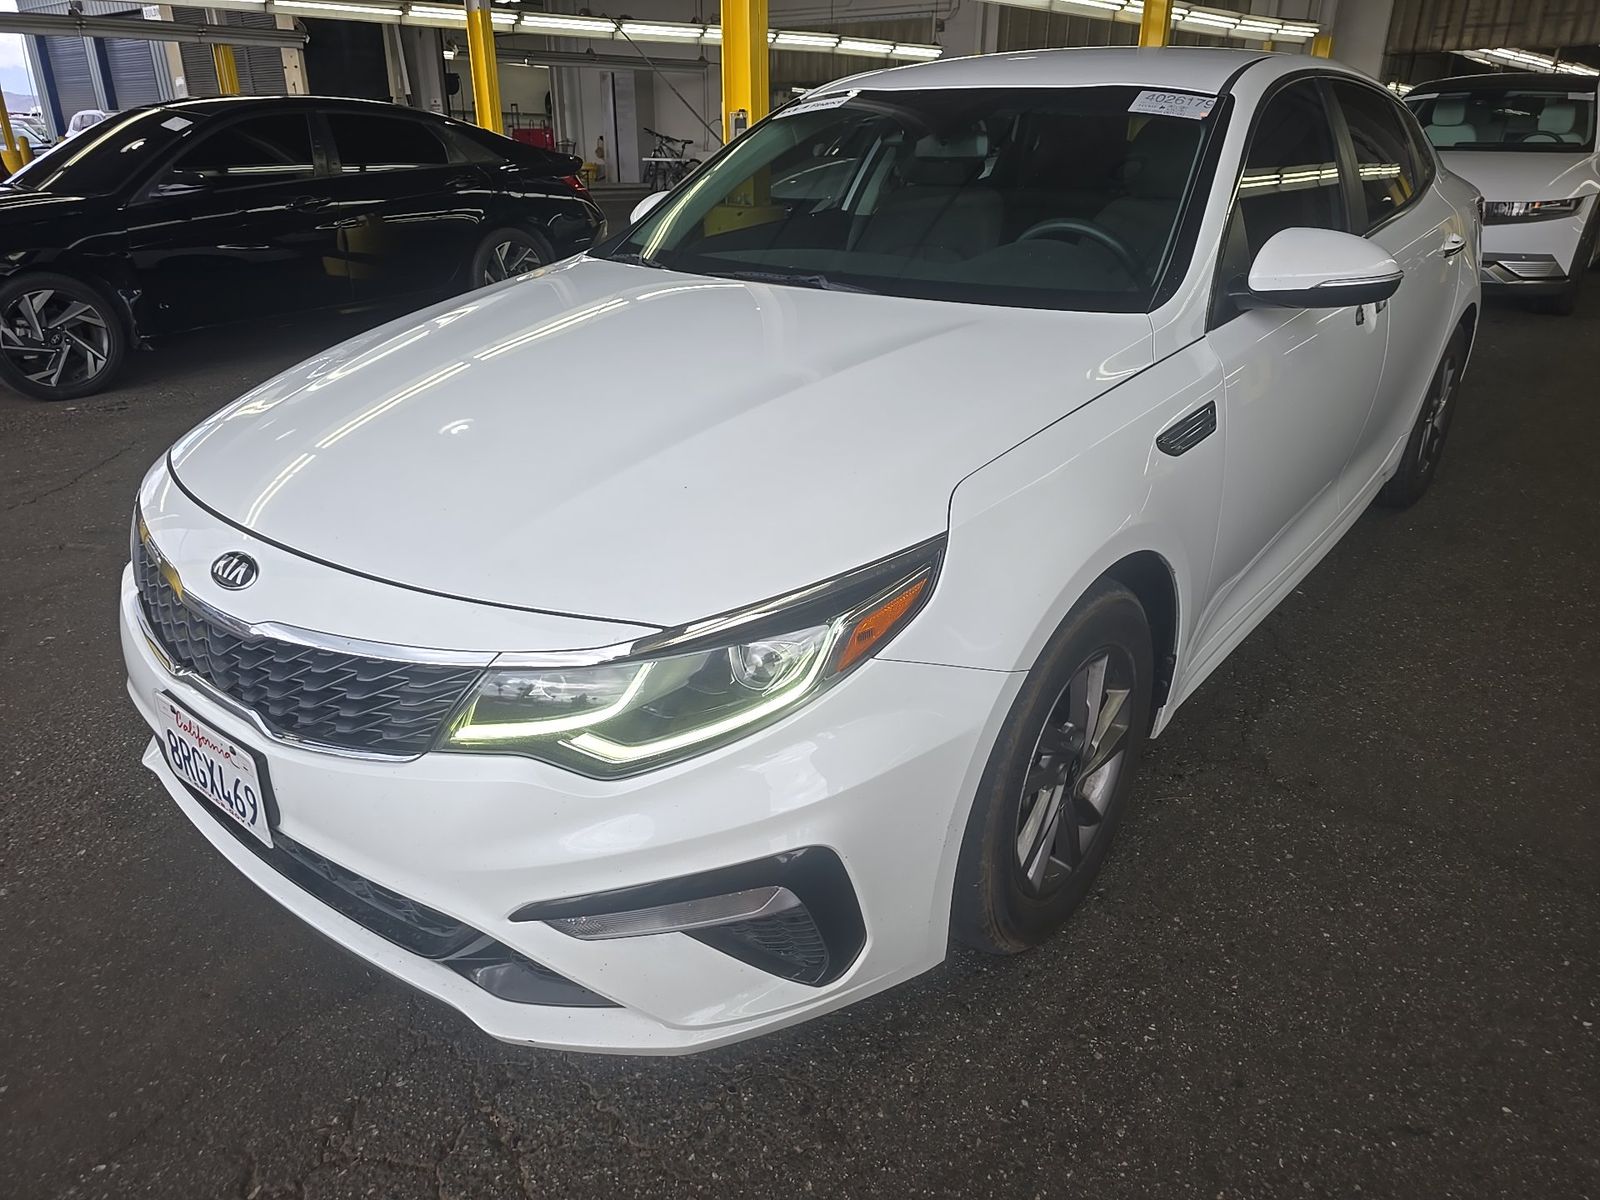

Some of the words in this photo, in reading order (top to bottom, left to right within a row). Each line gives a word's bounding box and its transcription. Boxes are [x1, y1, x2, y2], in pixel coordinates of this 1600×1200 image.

[213, 554, 249, 585] KIA
[174, 711, 232, 760] California
[167, 729, 258, 826] 8RGX469
